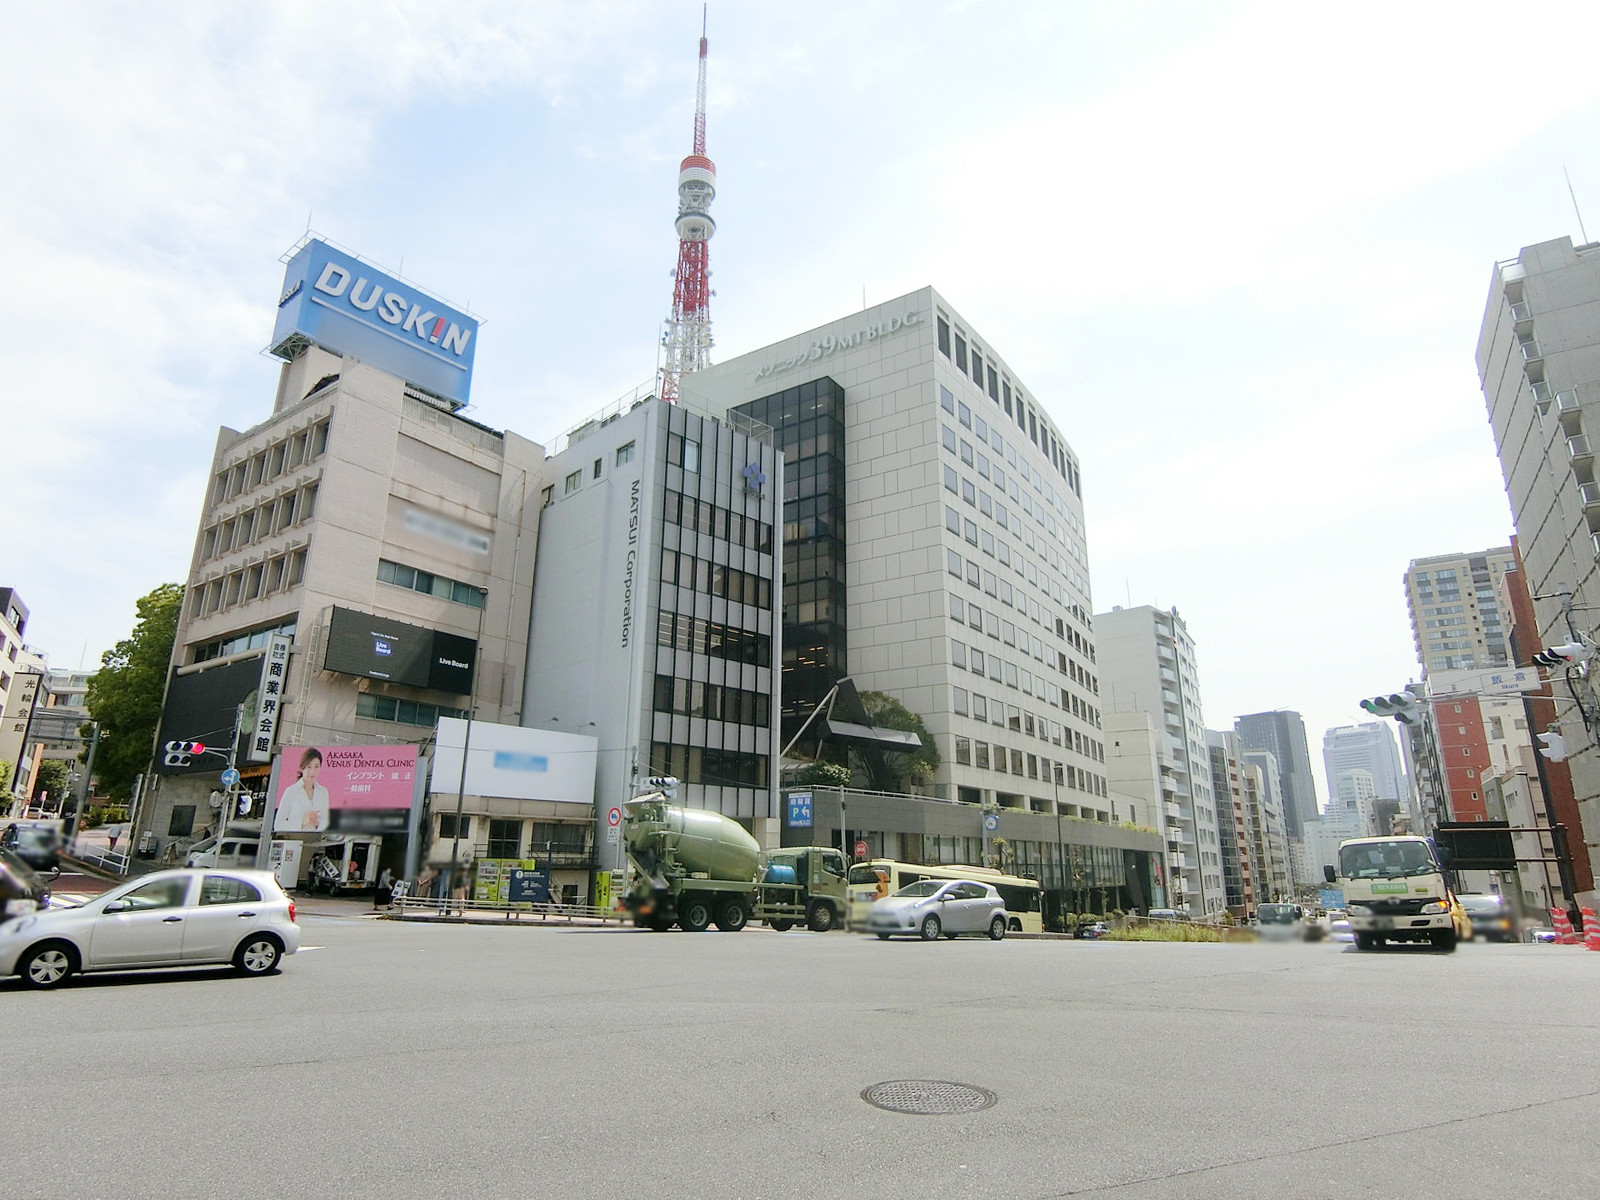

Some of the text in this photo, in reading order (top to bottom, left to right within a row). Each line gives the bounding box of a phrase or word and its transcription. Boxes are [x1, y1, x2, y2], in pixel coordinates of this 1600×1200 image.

[621, 479, 640, 648] MATSUI Corporation
[376, 641, 387, 649] Live
[375, 646, 391, 654] Board
[439, 657, 469, 669] Live Board
[13, 680, 36, 732] 光輪会館
[255, 662, 282, 752] 商業界会館
[327, 751, 363, 759] AKASAKA
[327, 759, 414, 768] VENUS DENTAL CLINIC
[347, 771, 384, 780] インプラント
[793, 807, 799, 817] P
